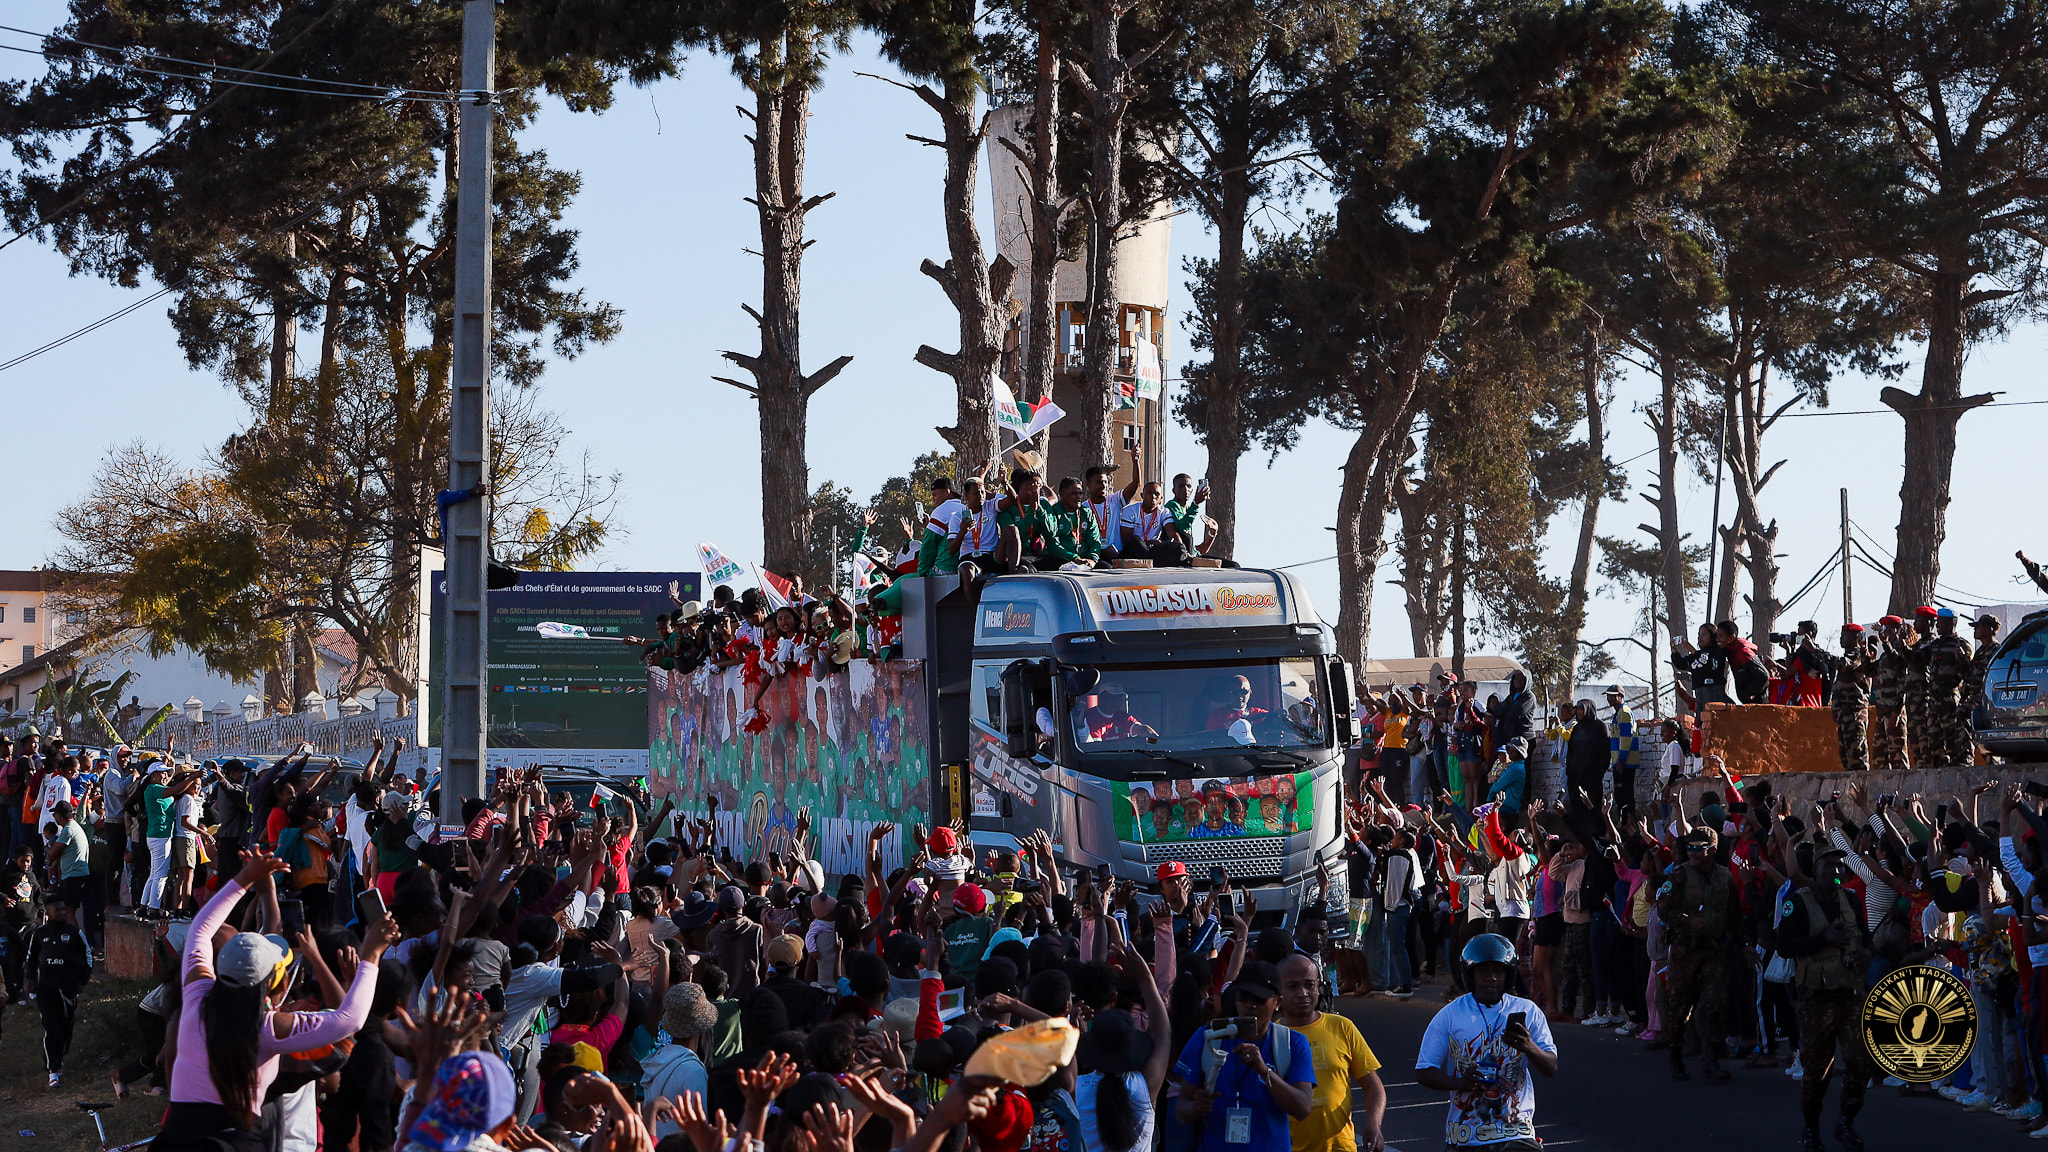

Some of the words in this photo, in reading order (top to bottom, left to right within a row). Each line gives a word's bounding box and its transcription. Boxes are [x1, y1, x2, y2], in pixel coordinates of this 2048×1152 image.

[525, 584, 543, 592] Chefs
[581, 585, 626, 594] gouvernement
[643, 585, 663, 593] SADC
[1098, 587, 1215, 615] TONGASOA
[1217, 587, 1277, 610] Barea
[1448, 1121, 1471, 1145] NO
